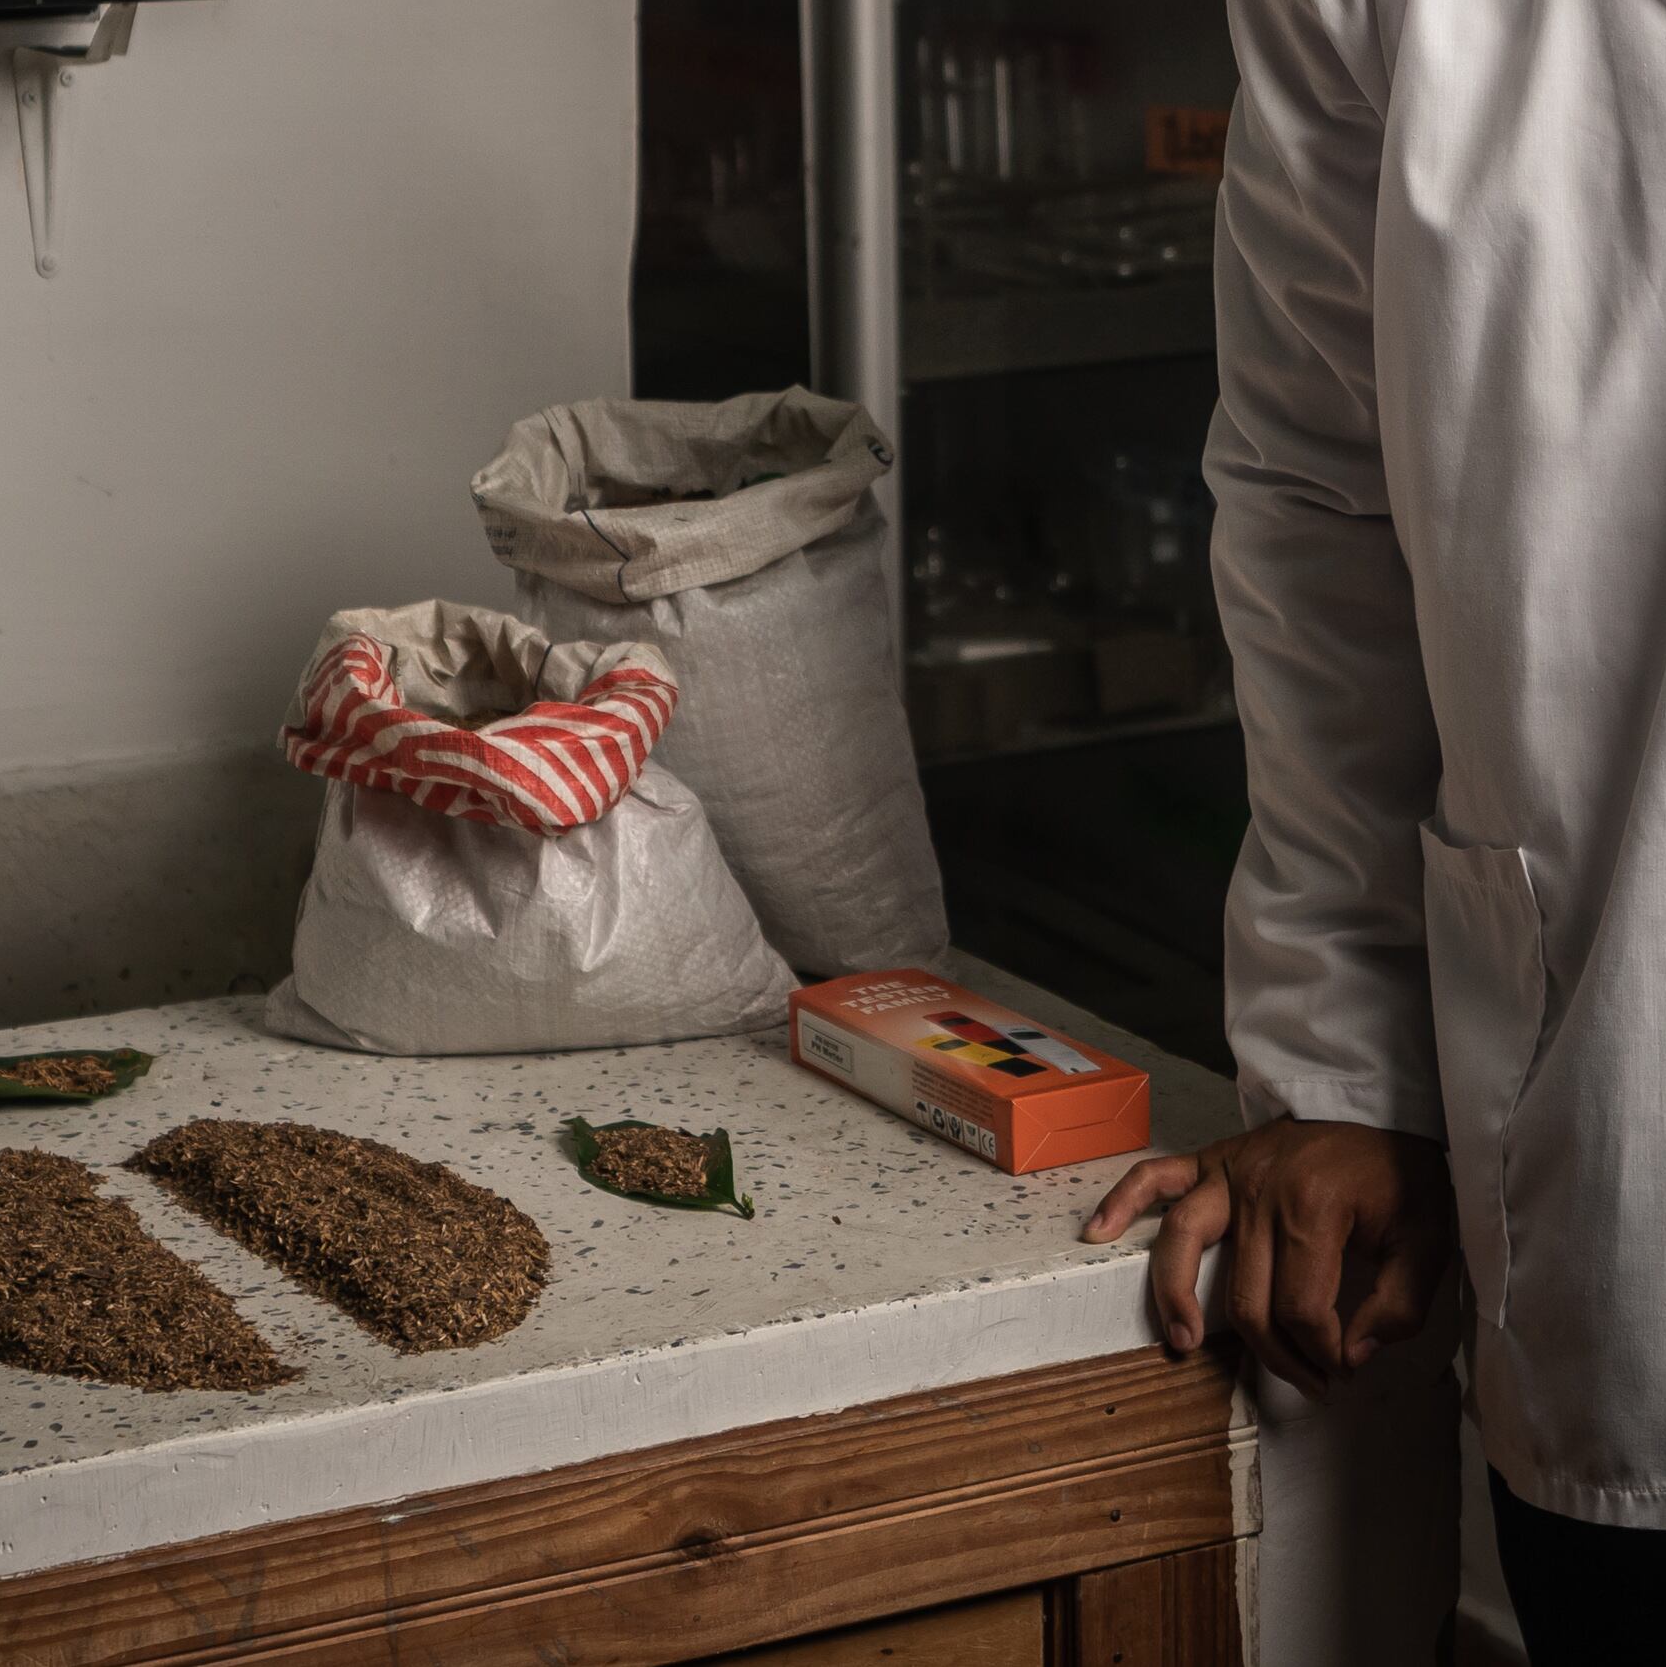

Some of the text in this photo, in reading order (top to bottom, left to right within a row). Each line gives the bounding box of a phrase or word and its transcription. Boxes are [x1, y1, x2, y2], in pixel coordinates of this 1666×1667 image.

[840, 986, 947, 1008] TESTER
[849, 981, 908, 994] THE
[860, 993, 951, 1015] FAMILY
